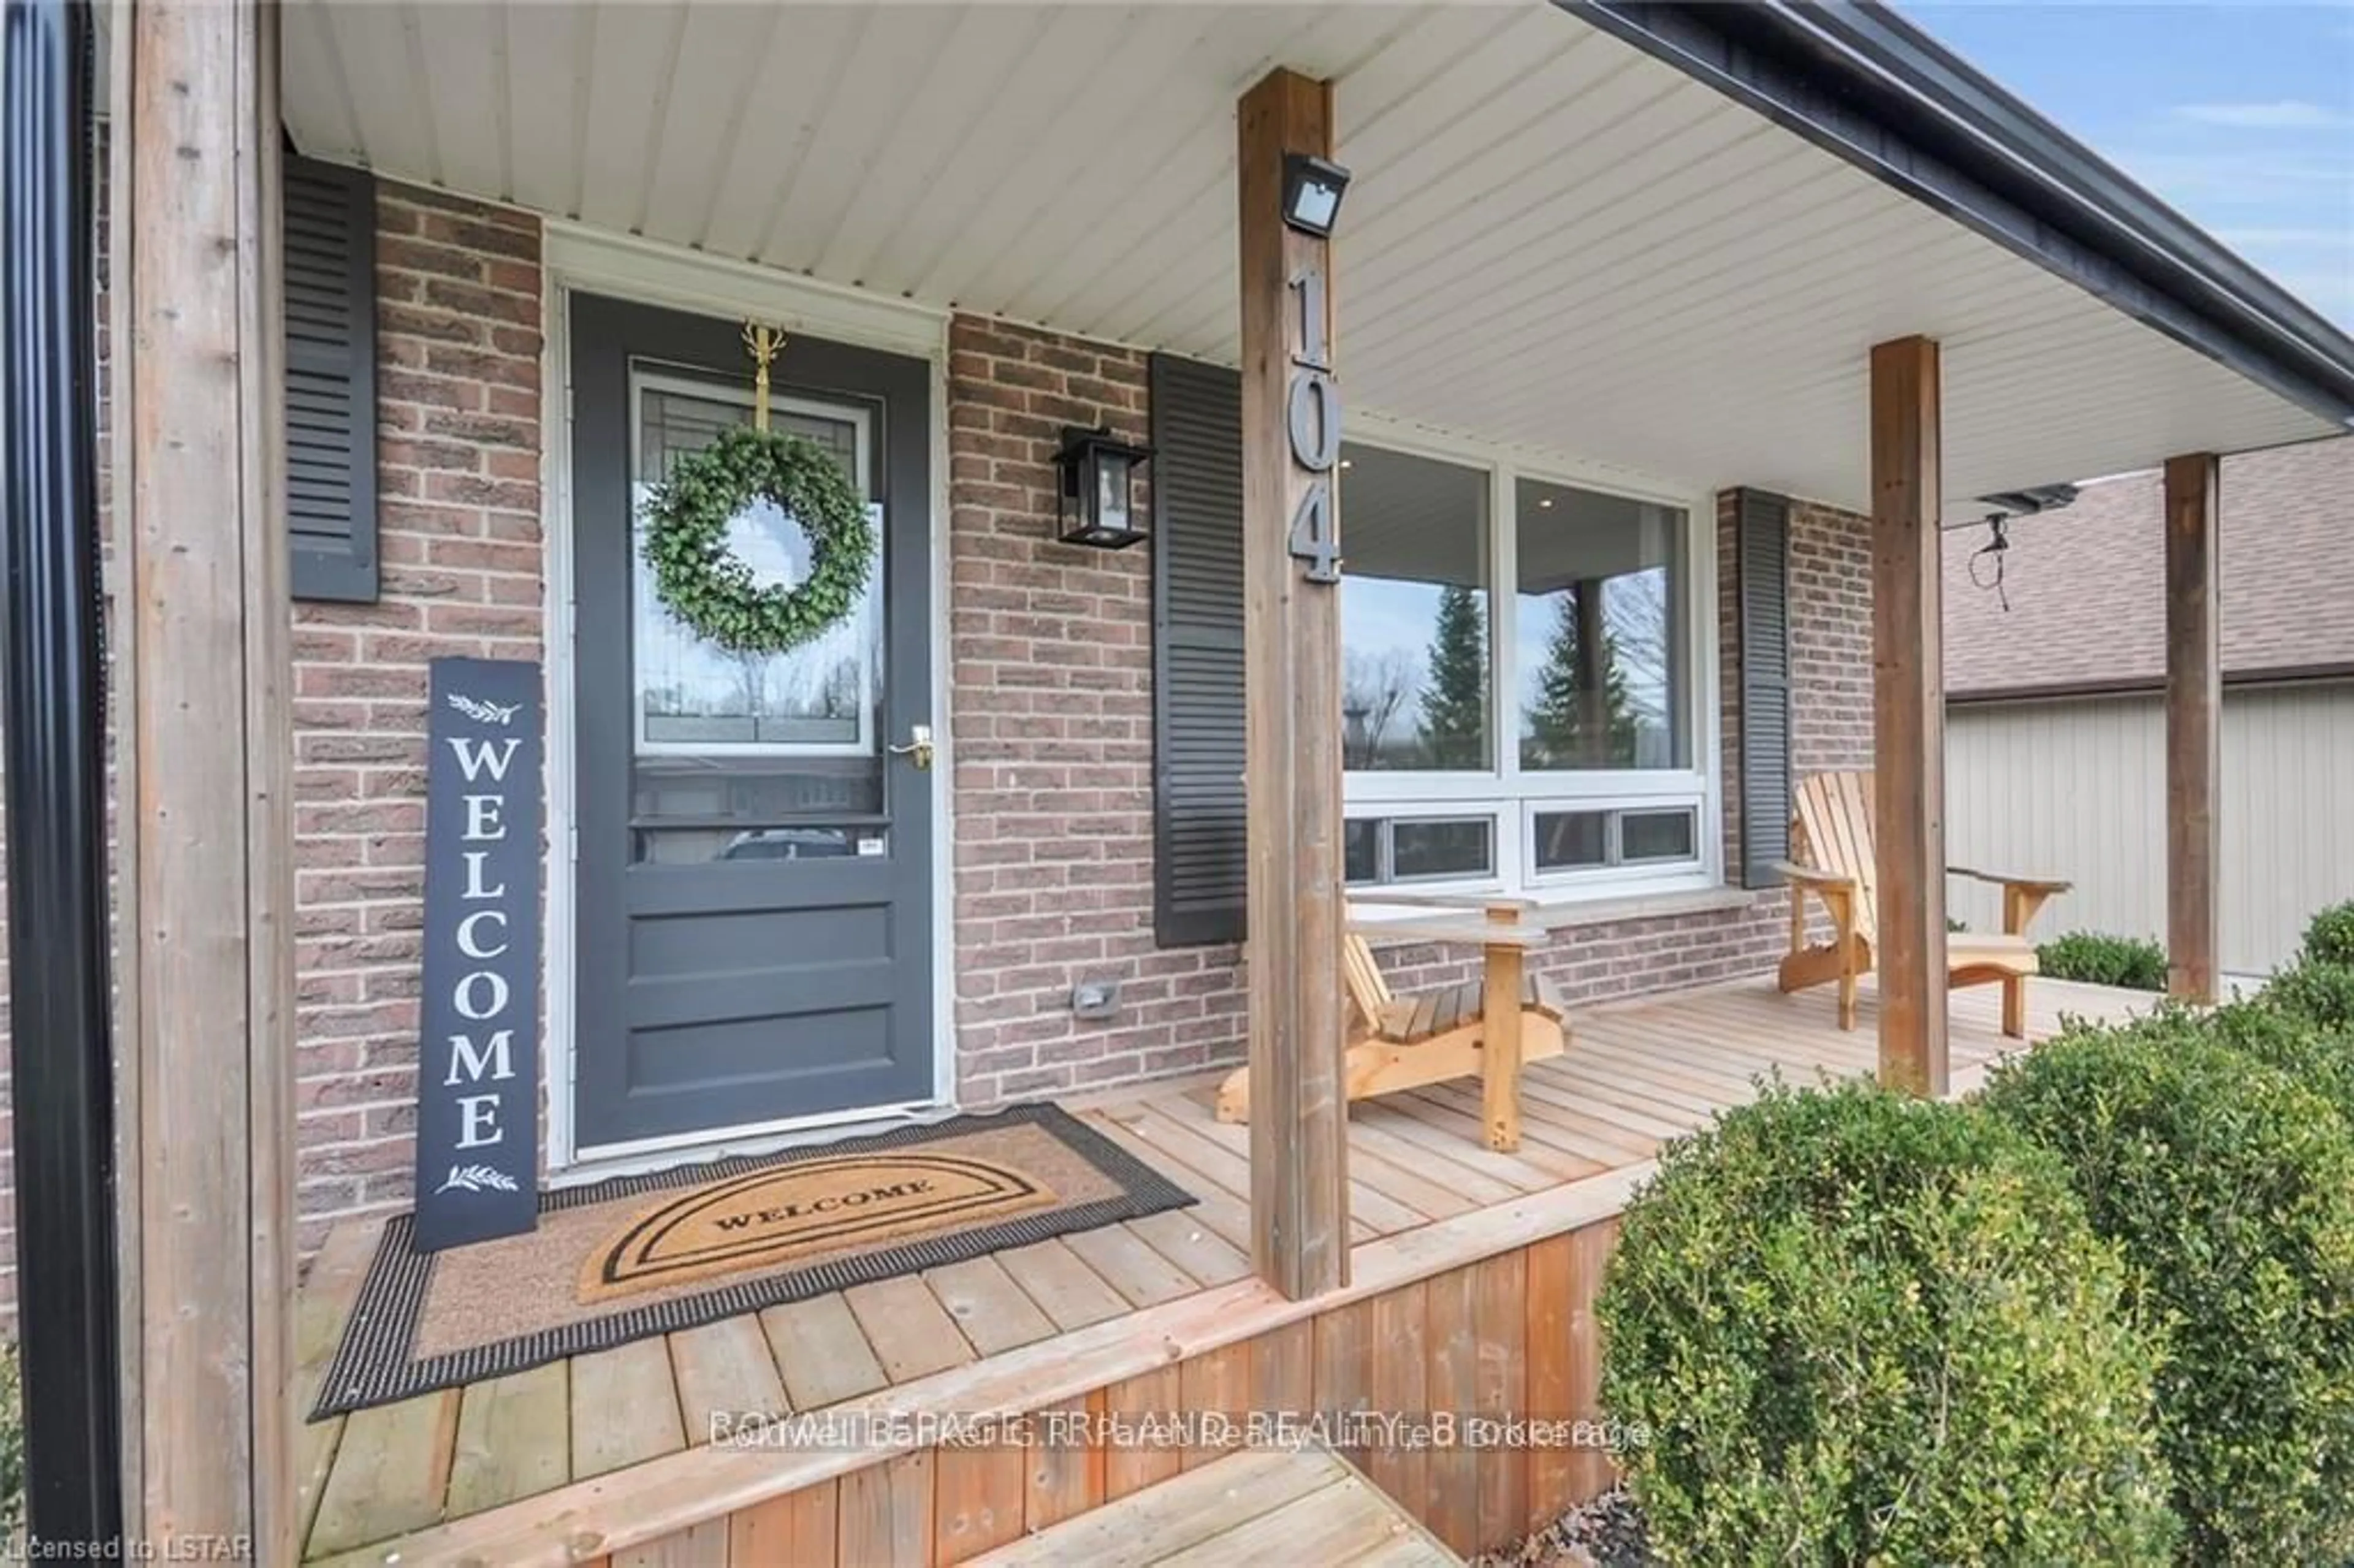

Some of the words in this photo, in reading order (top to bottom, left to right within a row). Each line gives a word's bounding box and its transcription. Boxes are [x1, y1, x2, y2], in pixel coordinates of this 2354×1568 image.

[1289, 268, 1341, 582] 104
[443, 736, 523, 1150] WELCOME
[715, 1178, 935, 1231] WELCOME
